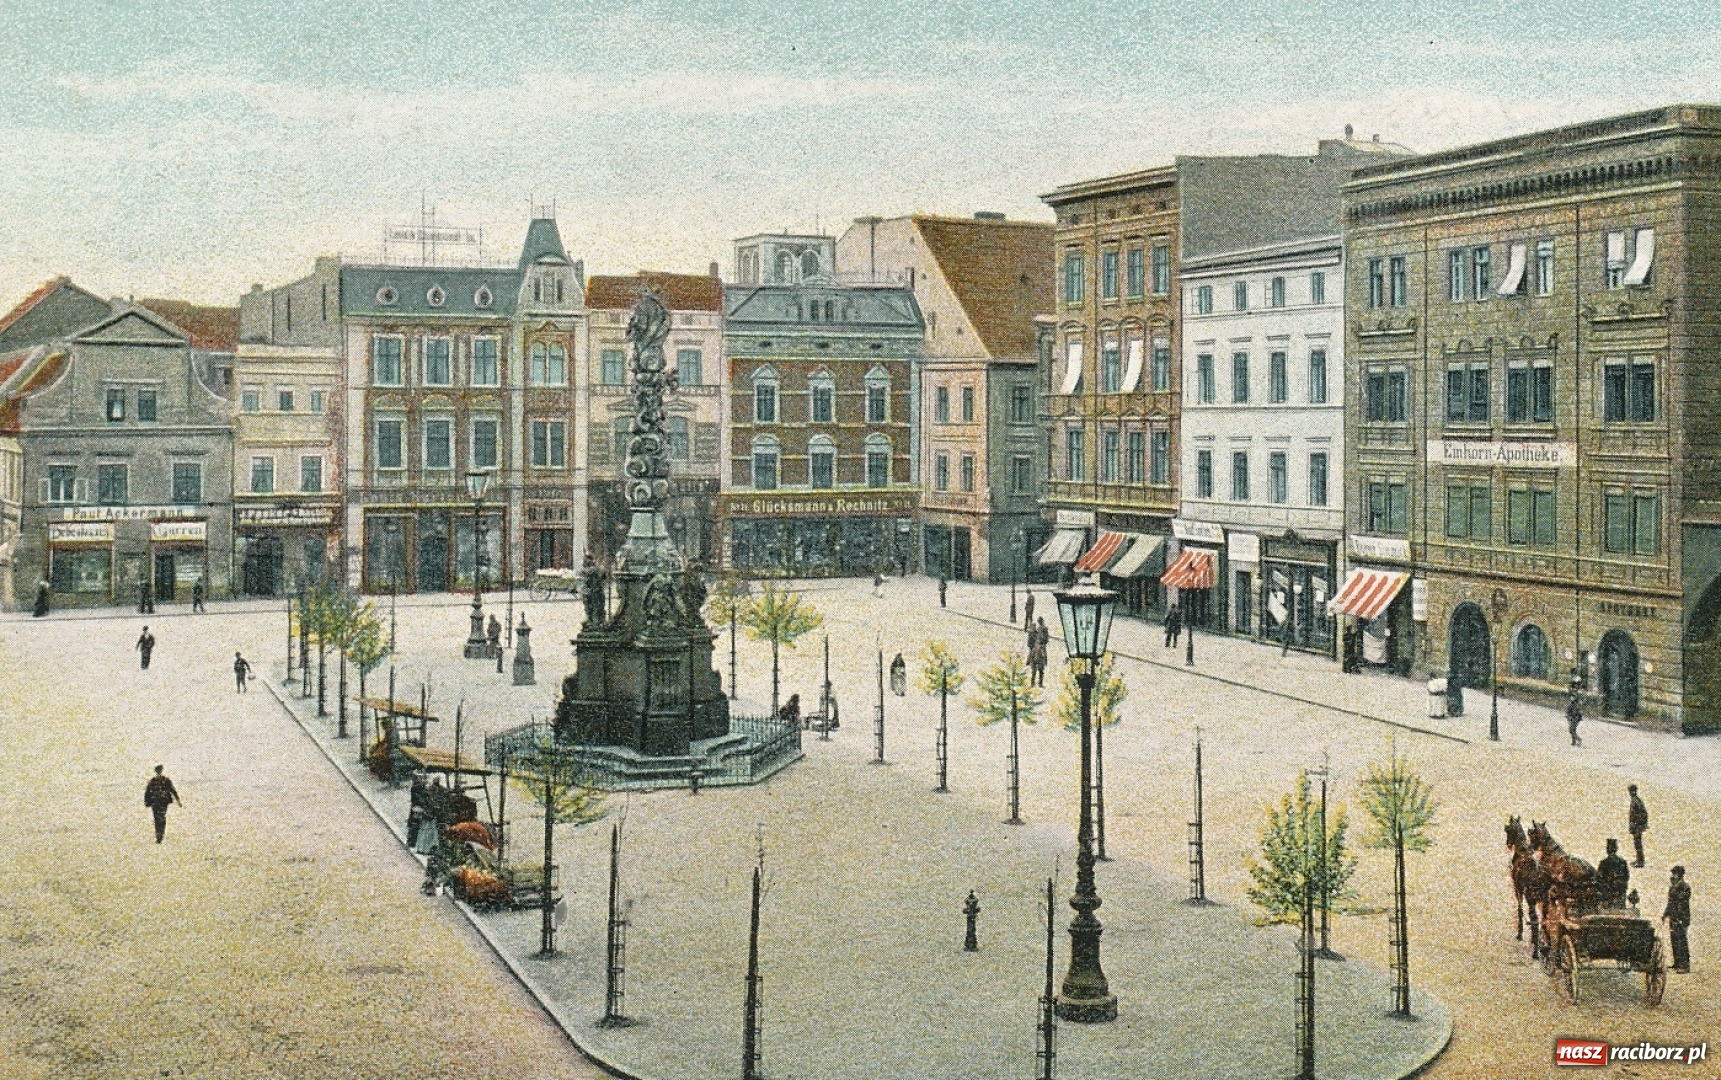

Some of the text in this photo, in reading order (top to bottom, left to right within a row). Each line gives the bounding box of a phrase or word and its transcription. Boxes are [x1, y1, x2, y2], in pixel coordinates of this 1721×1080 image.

[753, 500, 827, 513] Glücksmann
[73, 508, 183, 520] Paul Ackermann
